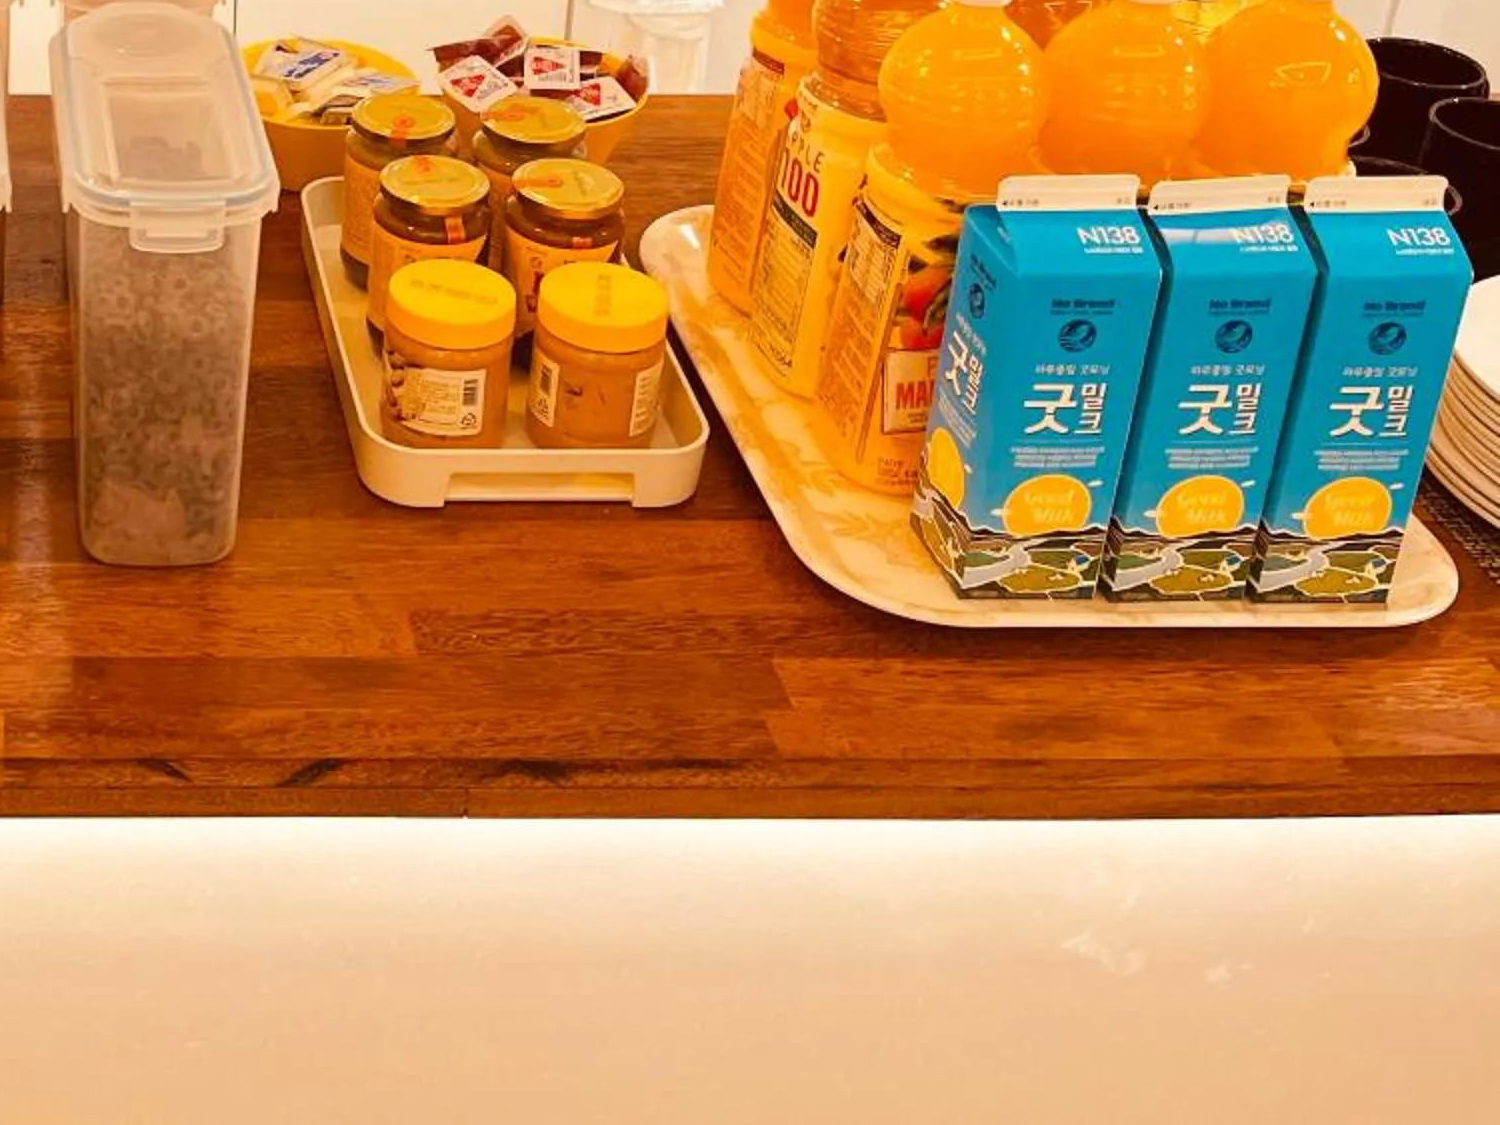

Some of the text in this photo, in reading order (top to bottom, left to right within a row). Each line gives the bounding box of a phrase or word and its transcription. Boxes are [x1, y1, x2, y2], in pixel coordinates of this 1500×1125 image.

[1076, 226, 1141, 245] N138
[1233, 222, 1294, 244] N138
[1386, 226, 1451, 247] N138
